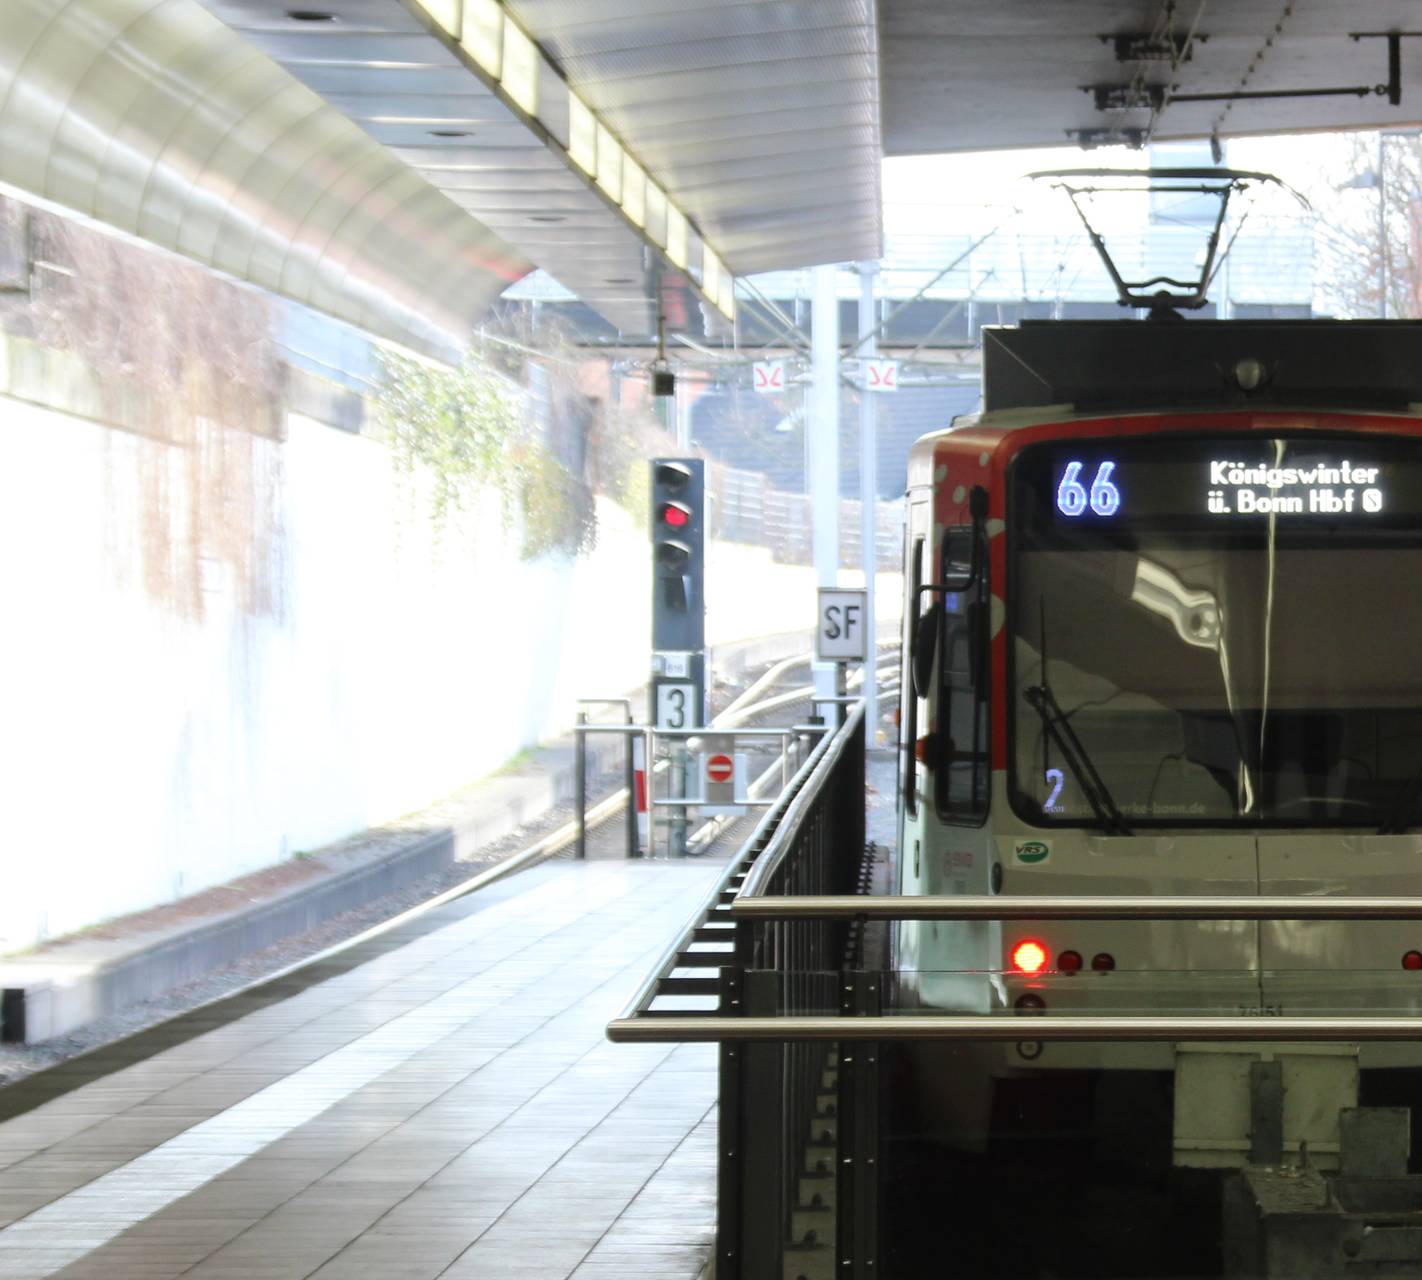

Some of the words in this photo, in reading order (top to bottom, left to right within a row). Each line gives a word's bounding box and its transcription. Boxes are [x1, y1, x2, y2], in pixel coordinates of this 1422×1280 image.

[1057, 461, 1121, 516] 66
[1210, 460, 1379, 488] Königswinter
[1208, 490, 1230, 514] ü.
[1237, 489, 1303, 514] Bonn
[1309, 489, 1354, 513] Hbf
[824, 605, 860, 640] SF
[666, 688, 685, 729] 3
[1043, 768, 1064, 813] 2
